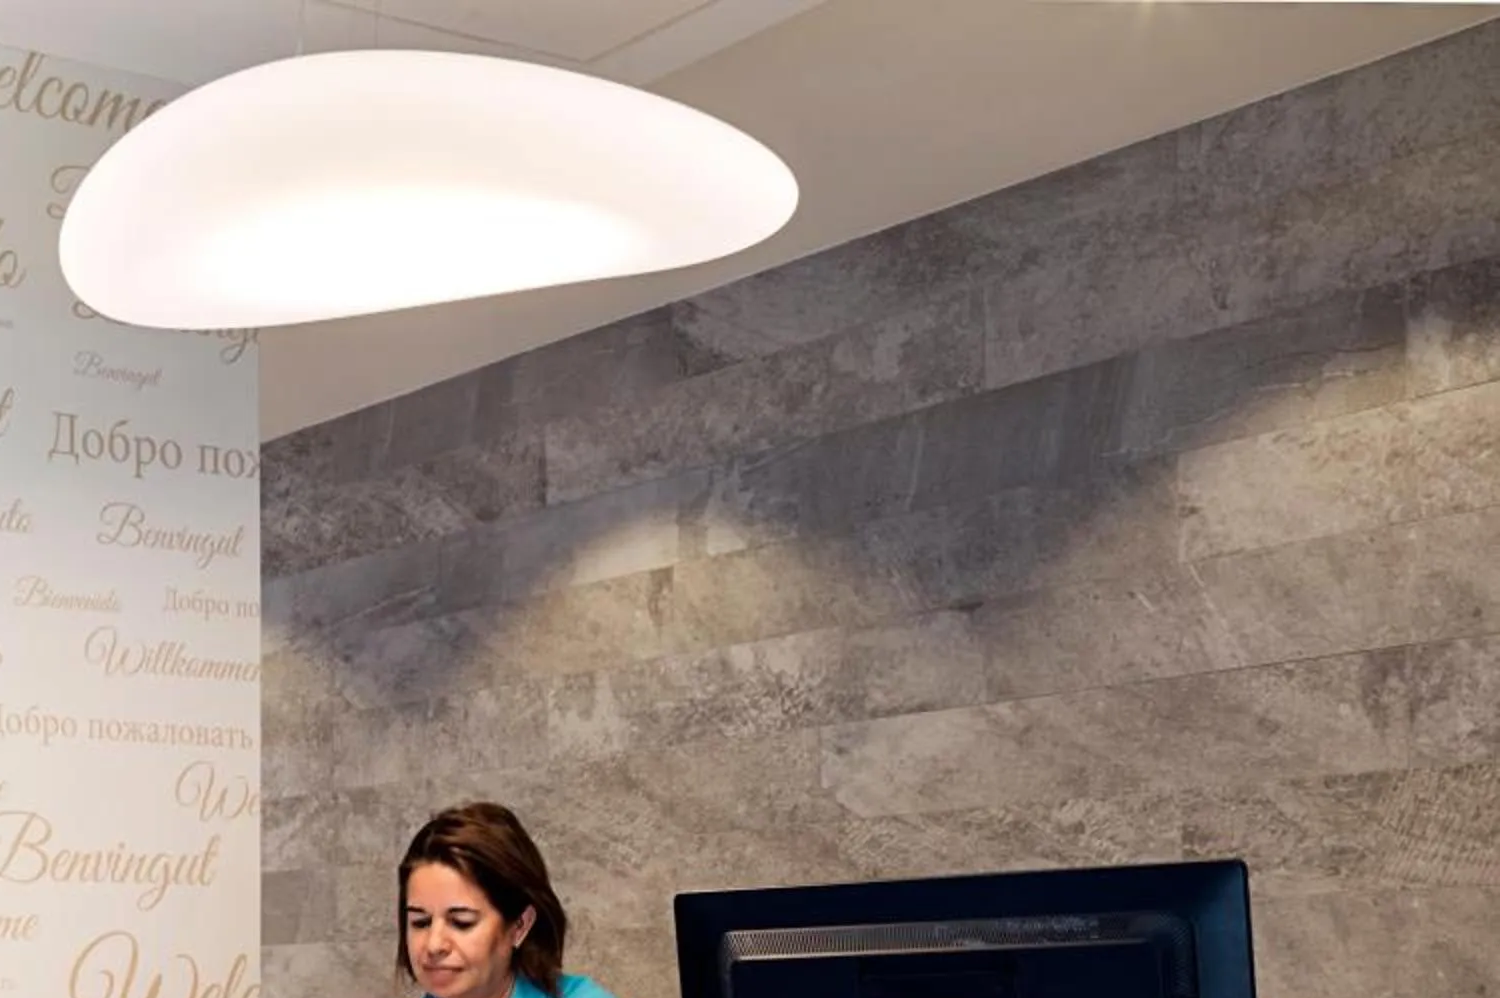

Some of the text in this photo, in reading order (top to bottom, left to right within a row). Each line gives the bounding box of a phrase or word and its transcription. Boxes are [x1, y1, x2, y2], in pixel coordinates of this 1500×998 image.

[48, 411, 184, 479] Добро
[96, 501, 243, 568] Benvingut
[88, 717, 253, 749] пожаловать
